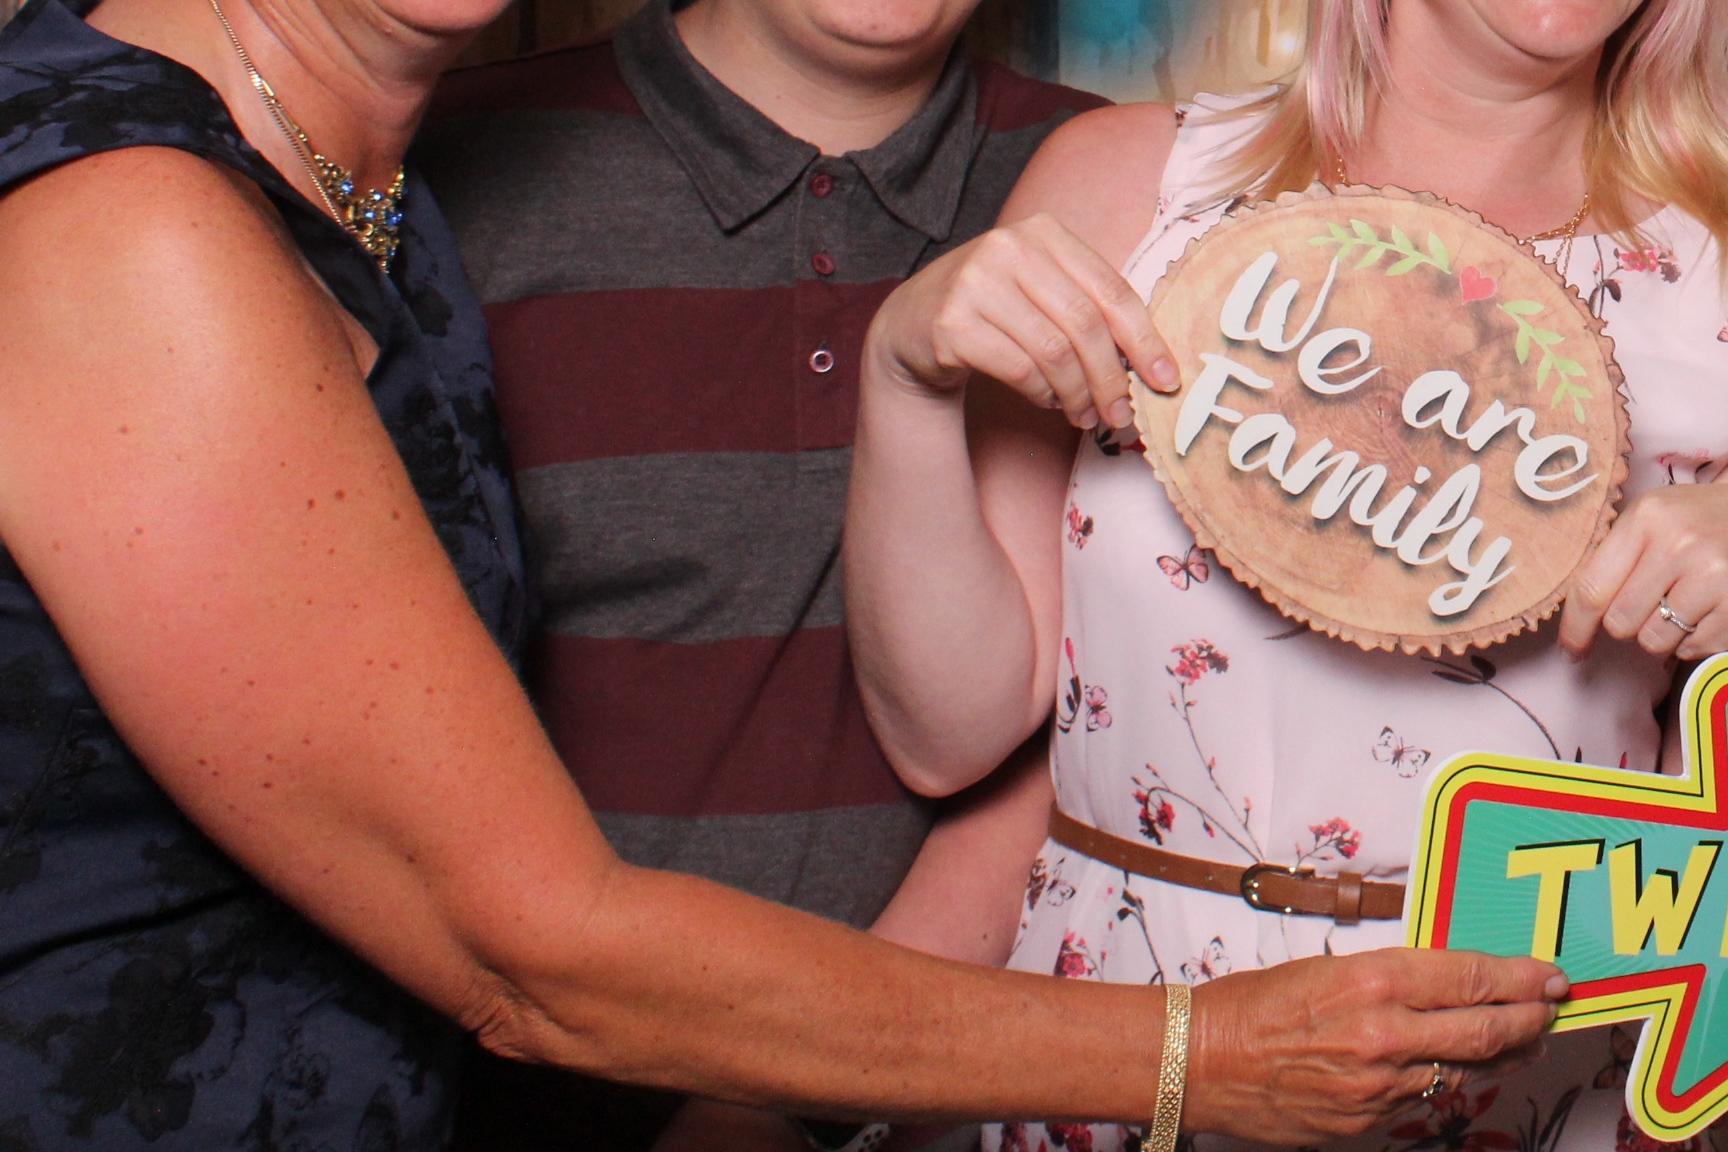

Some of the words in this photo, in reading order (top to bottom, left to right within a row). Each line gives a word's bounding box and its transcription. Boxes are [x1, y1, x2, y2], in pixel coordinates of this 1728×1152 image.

[1174, 352, 1517, 617] Family
[1219, 250, 1383, 396] We
[1401, 369, 1600, 502] are
